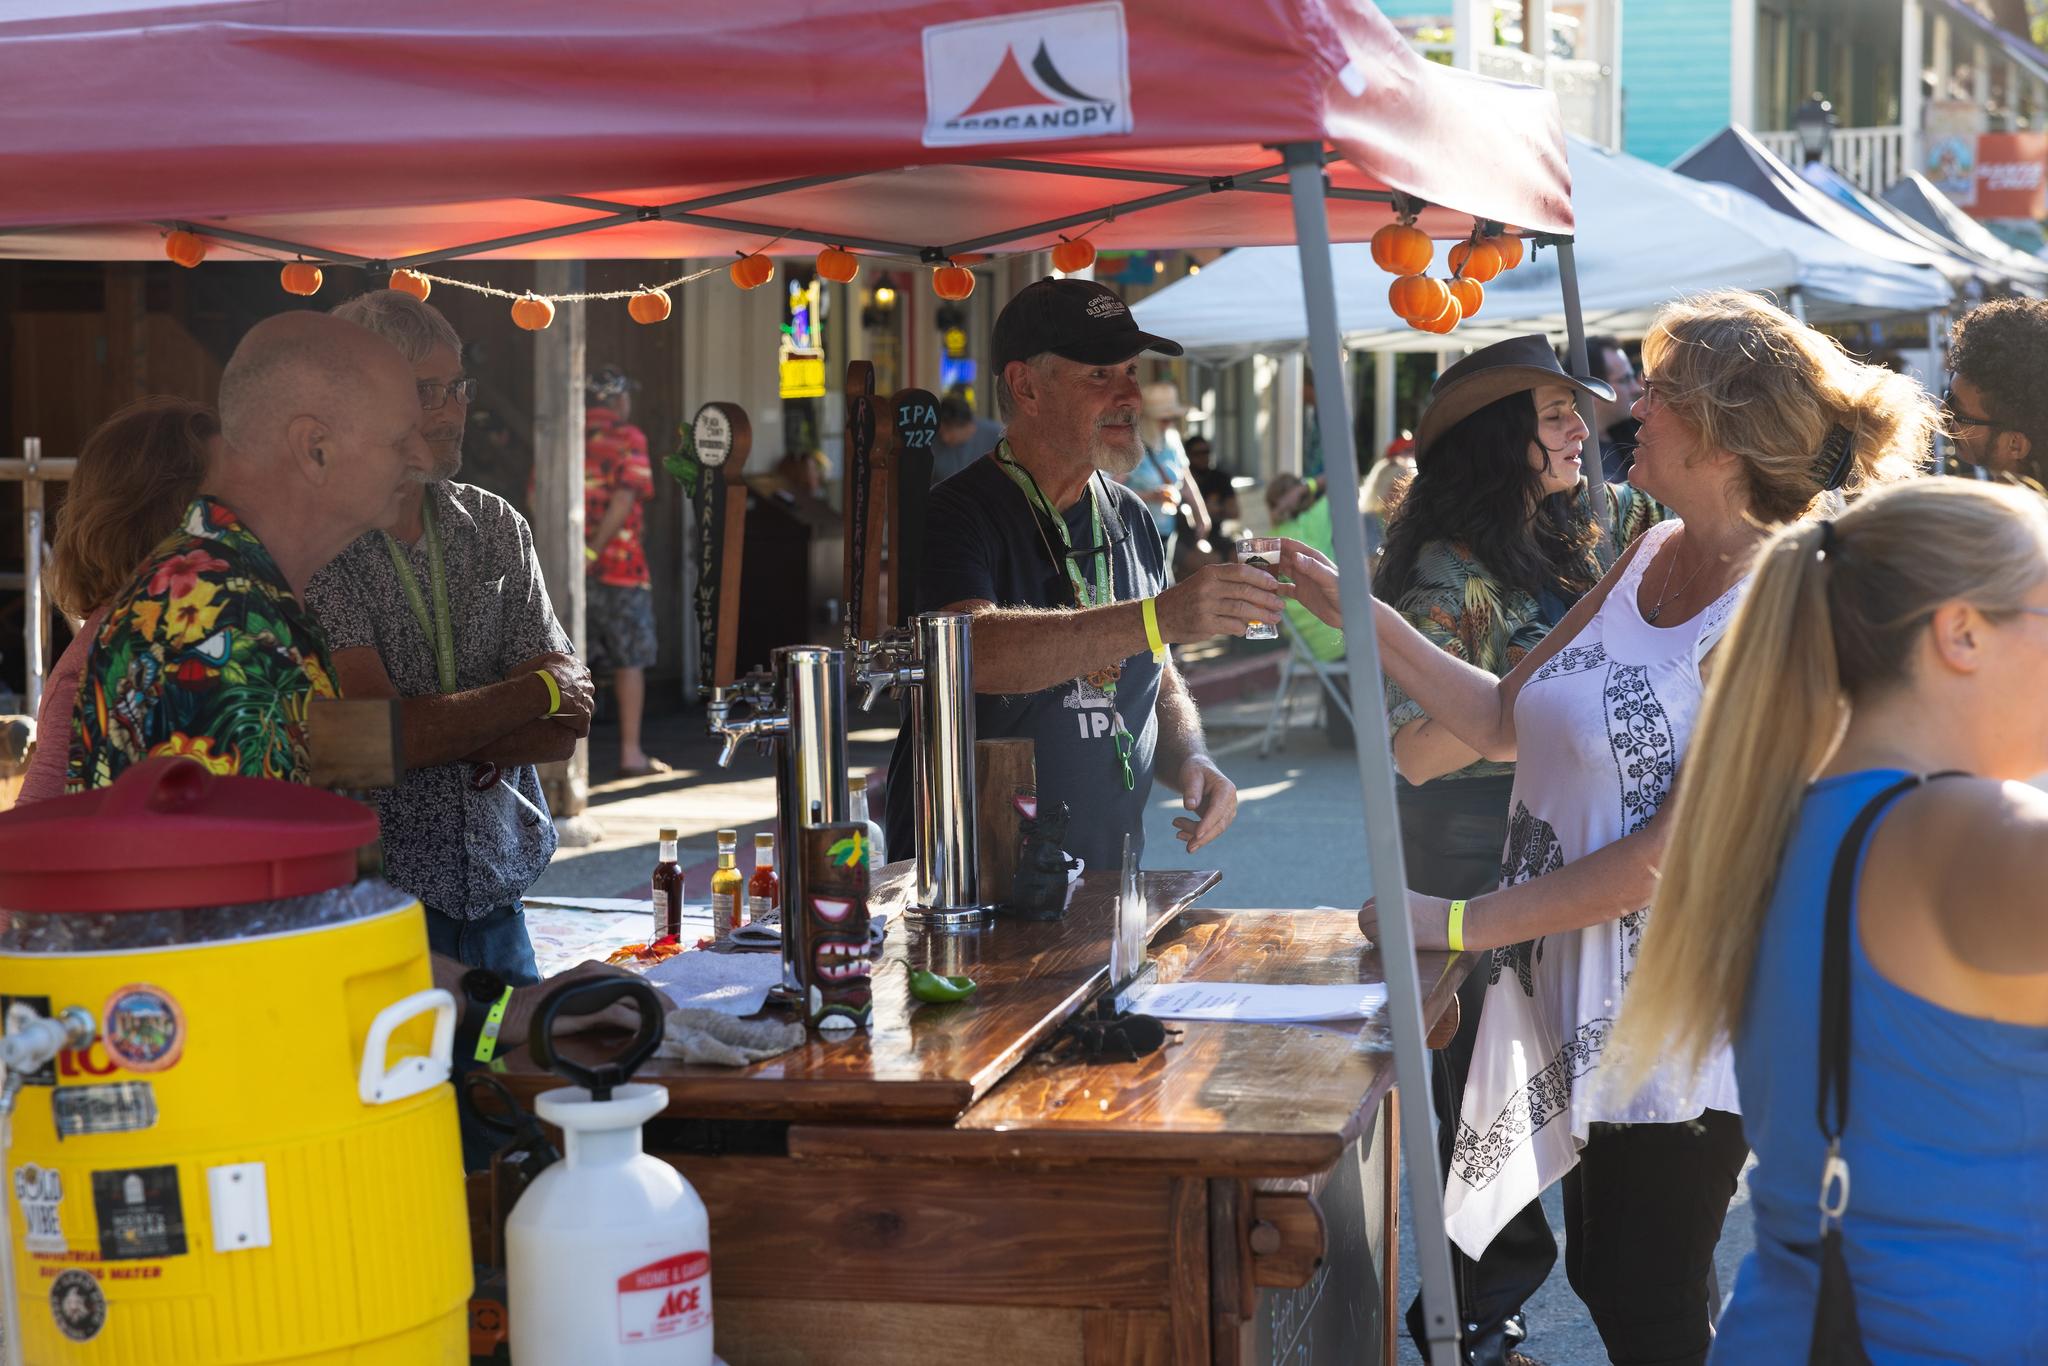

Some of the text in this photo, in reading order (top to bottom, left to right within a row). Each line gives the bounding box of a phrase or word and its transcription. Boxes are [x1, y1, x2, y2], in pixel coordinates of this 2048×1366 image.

[1086, 306, 1101, 316] OLD
[899, 405, 937, 426] IPA
[702, 468, 715, 577] BARLEY
[658, 1286, 701, 1318] ACE
